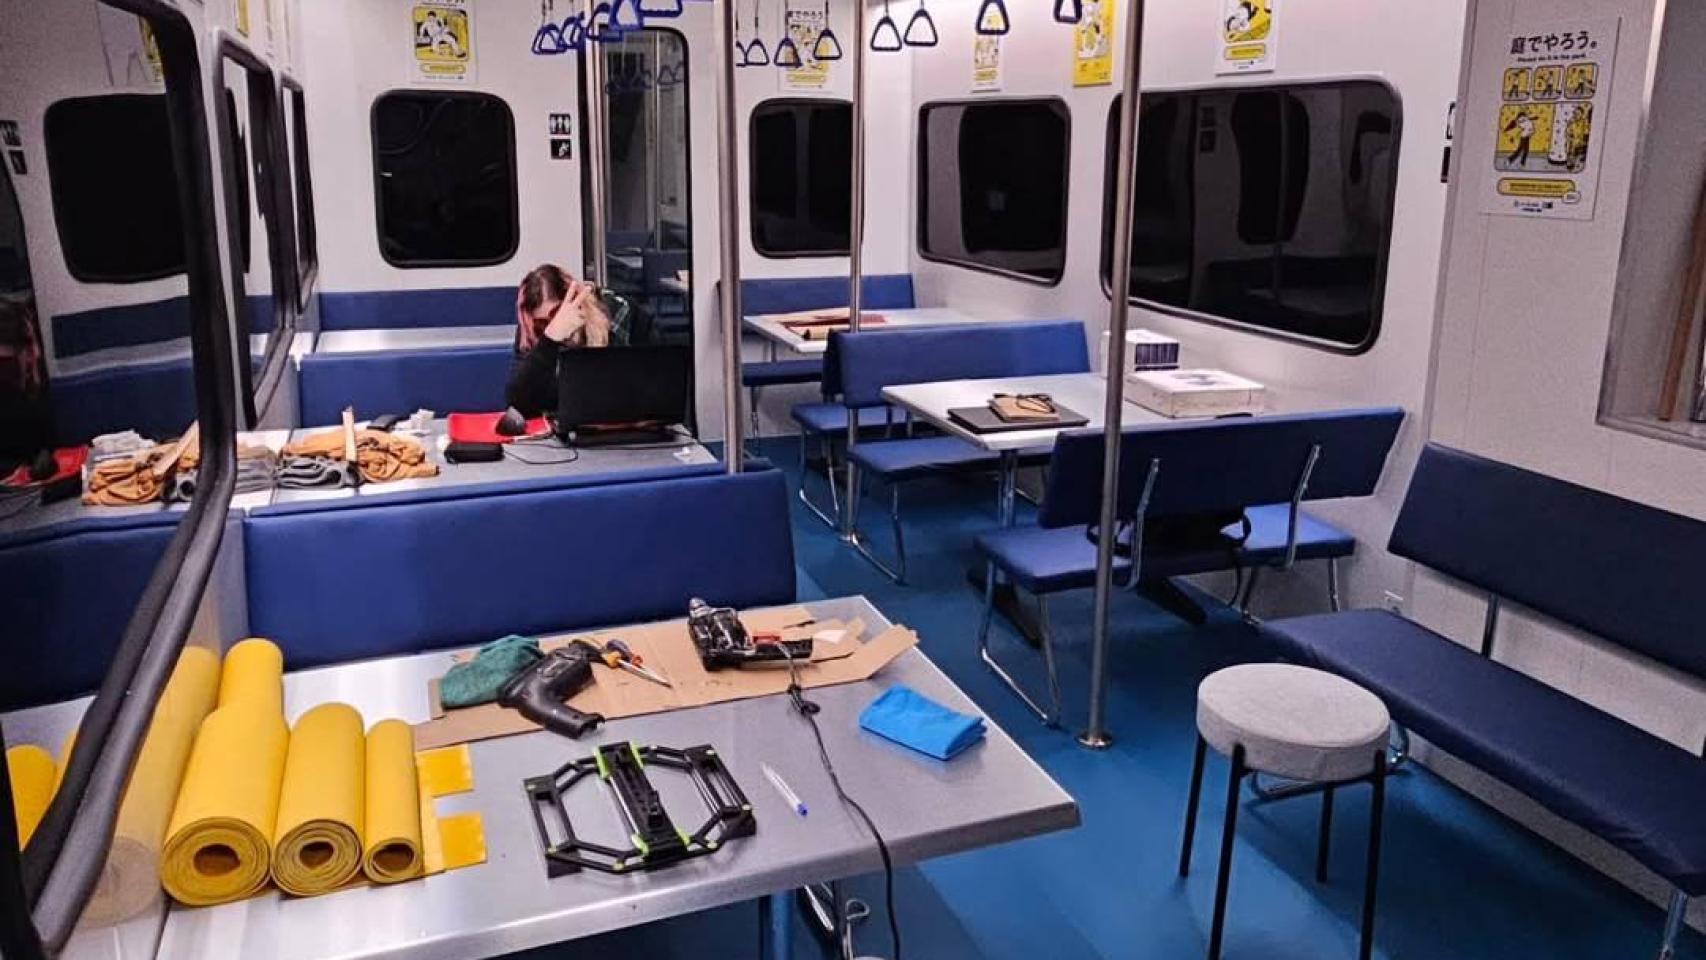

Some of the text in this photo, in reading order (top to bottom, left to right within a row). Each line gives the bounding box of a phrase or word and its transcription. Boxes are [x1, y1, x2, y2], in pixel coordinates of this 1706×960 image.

[1511, 31, 1597, 54] 庭でやろう。
